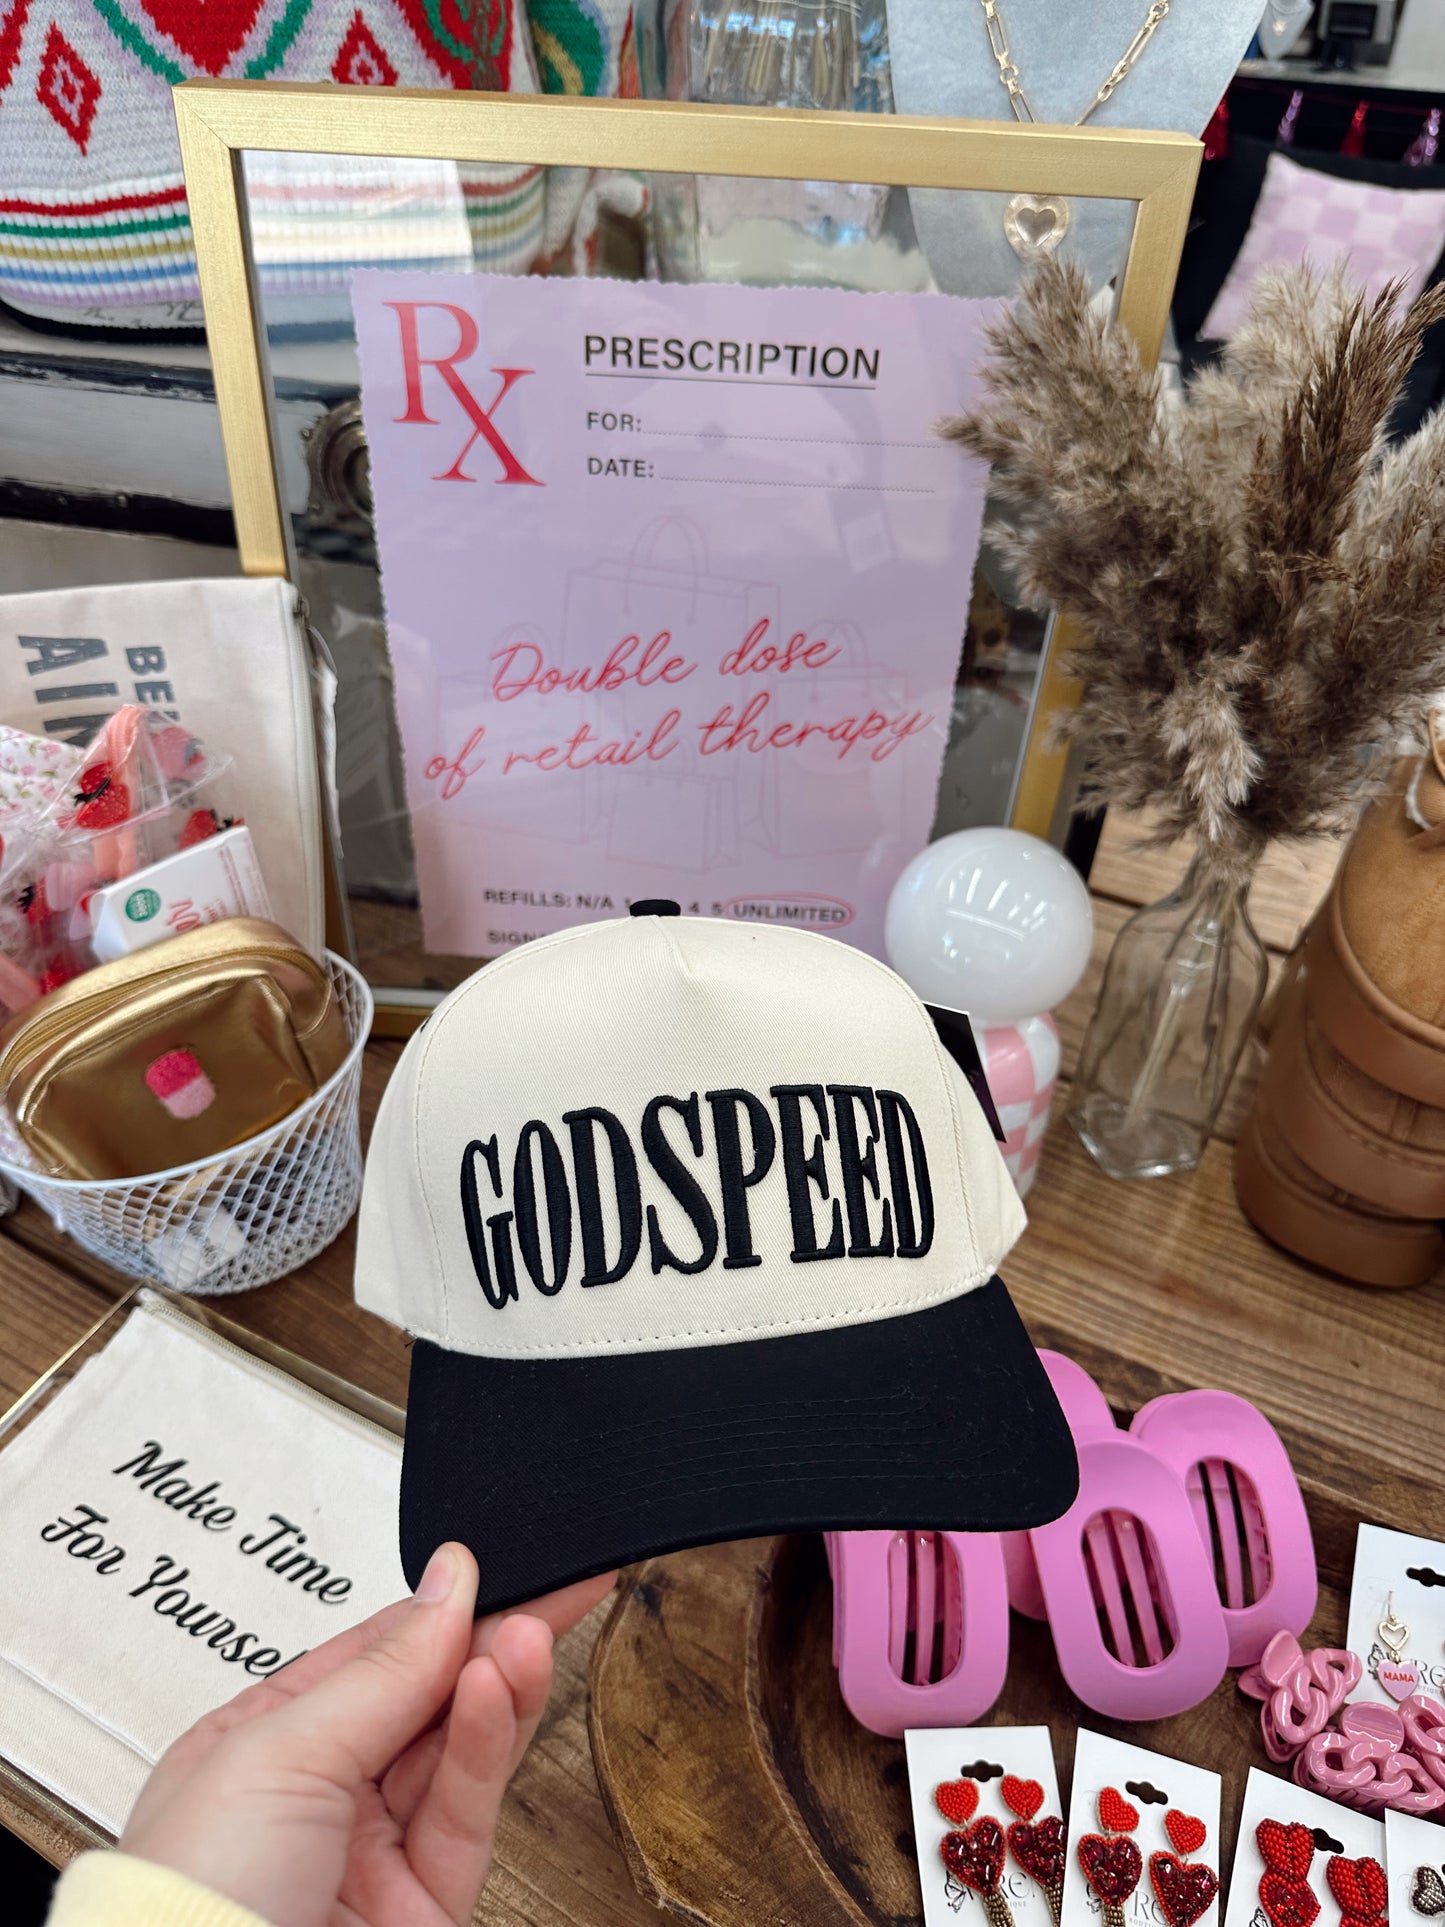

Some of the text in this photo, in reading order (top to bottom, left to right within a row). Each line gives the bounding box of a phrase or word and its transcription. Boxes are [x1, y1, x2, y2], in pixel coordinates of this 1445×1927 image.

[584, 335, 882, 380] PRESCRIPTION
[587, 411, 642, 433] FOR:
[588, 457, 654, 479] DATE:
[489, 617, 842, 702] Double dose
[424, 691, 935, 801] of retail therapy
[483, 887, 571, 909] REFILLS:
[576, 893, 614, 911] N/A
[687, 901, 699, 914] 4
[711, 901, 722, 915] 5
[733, 902, 847, 923] UNLIMITED
[486, 928, 548, 946] SIGN
[459, 1083, 936, 1310] GODSPEED
[40, 1504, 127, 1575] For
[112, 1440, 354, 1605] Make Time
[1383, 1671, 1415, 1683] MAMA
